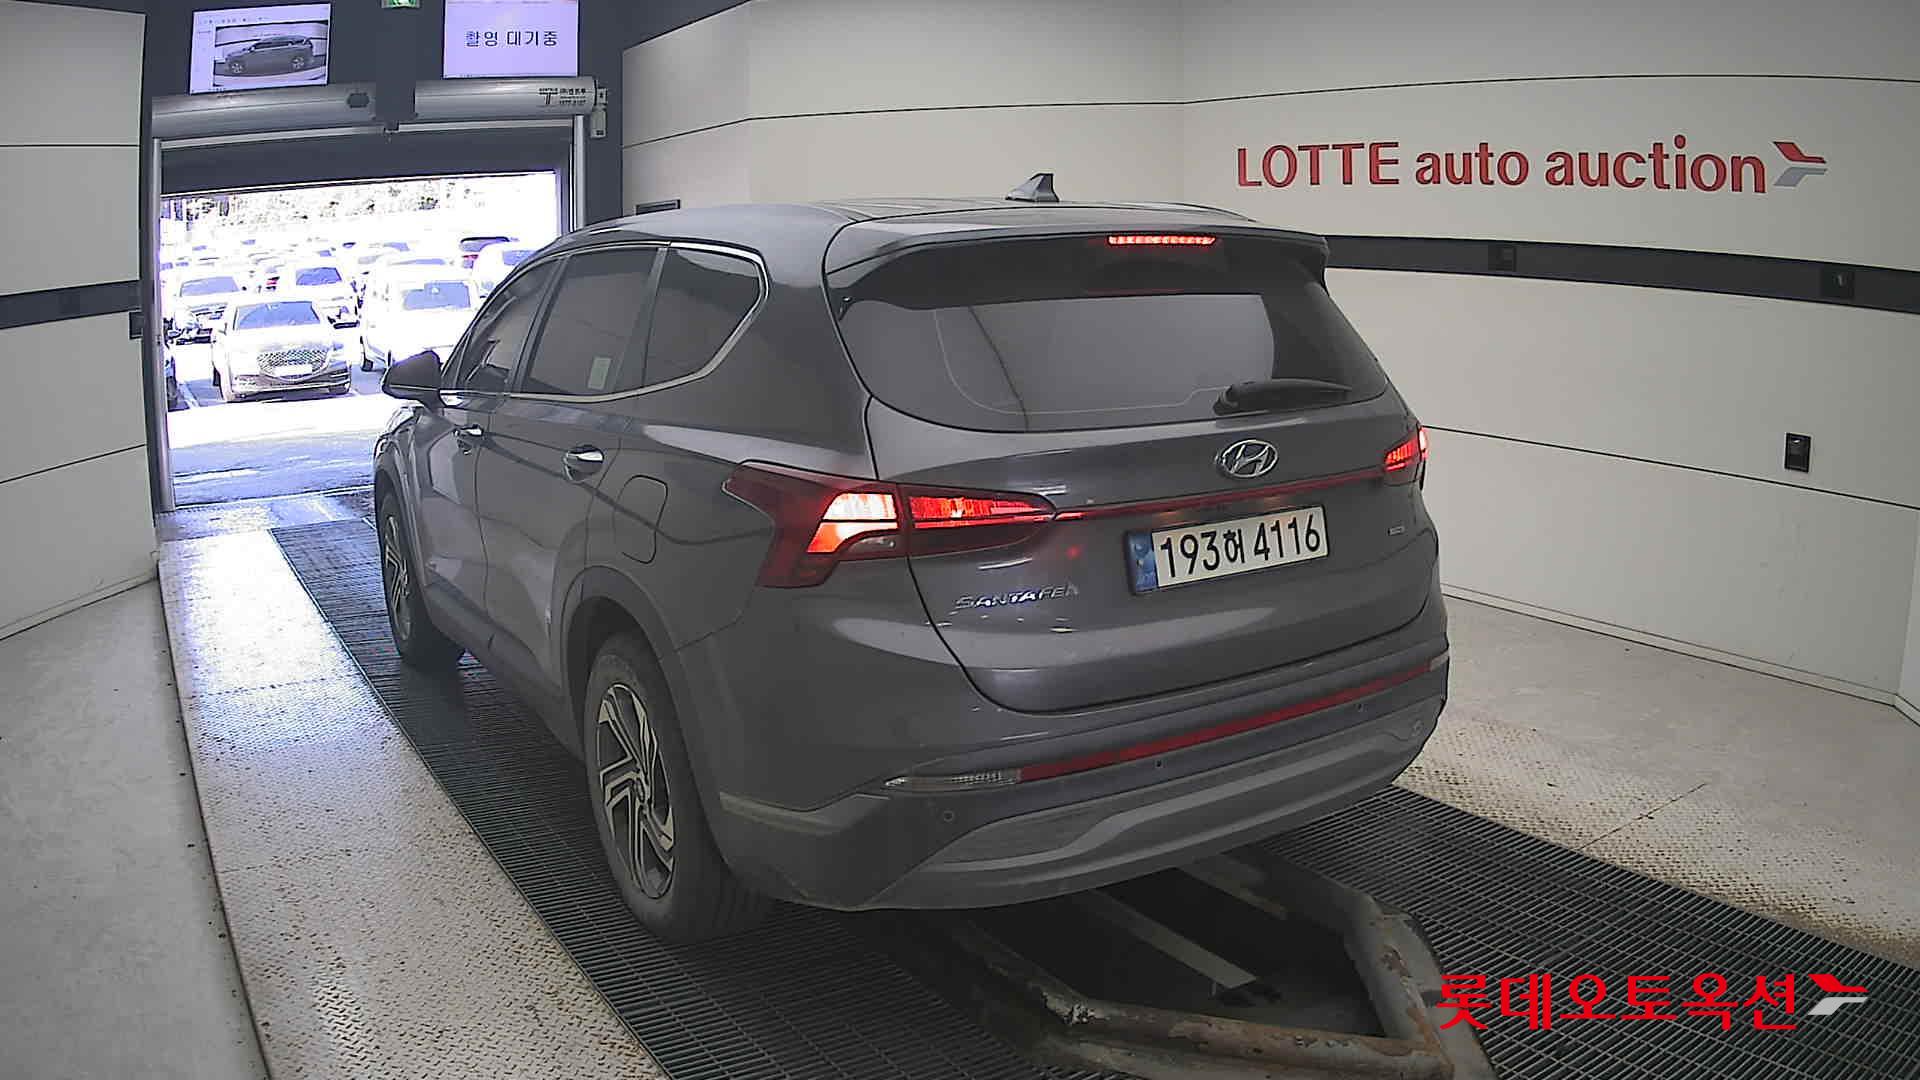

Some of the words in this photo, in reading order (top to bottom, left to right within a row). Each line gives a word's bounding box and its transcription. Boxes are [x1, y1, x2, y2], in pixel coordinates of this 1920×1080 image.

[506, 31, 558, 47] 대기중
[1237, 141, 1400, 188] LOTTE
[1415, 142, 1530, 186] auto
[1544, 134, 1767, 194] auction
[1160, 528, 1246, 578] 193허
[1253, 513, 1321, 561] 4116
